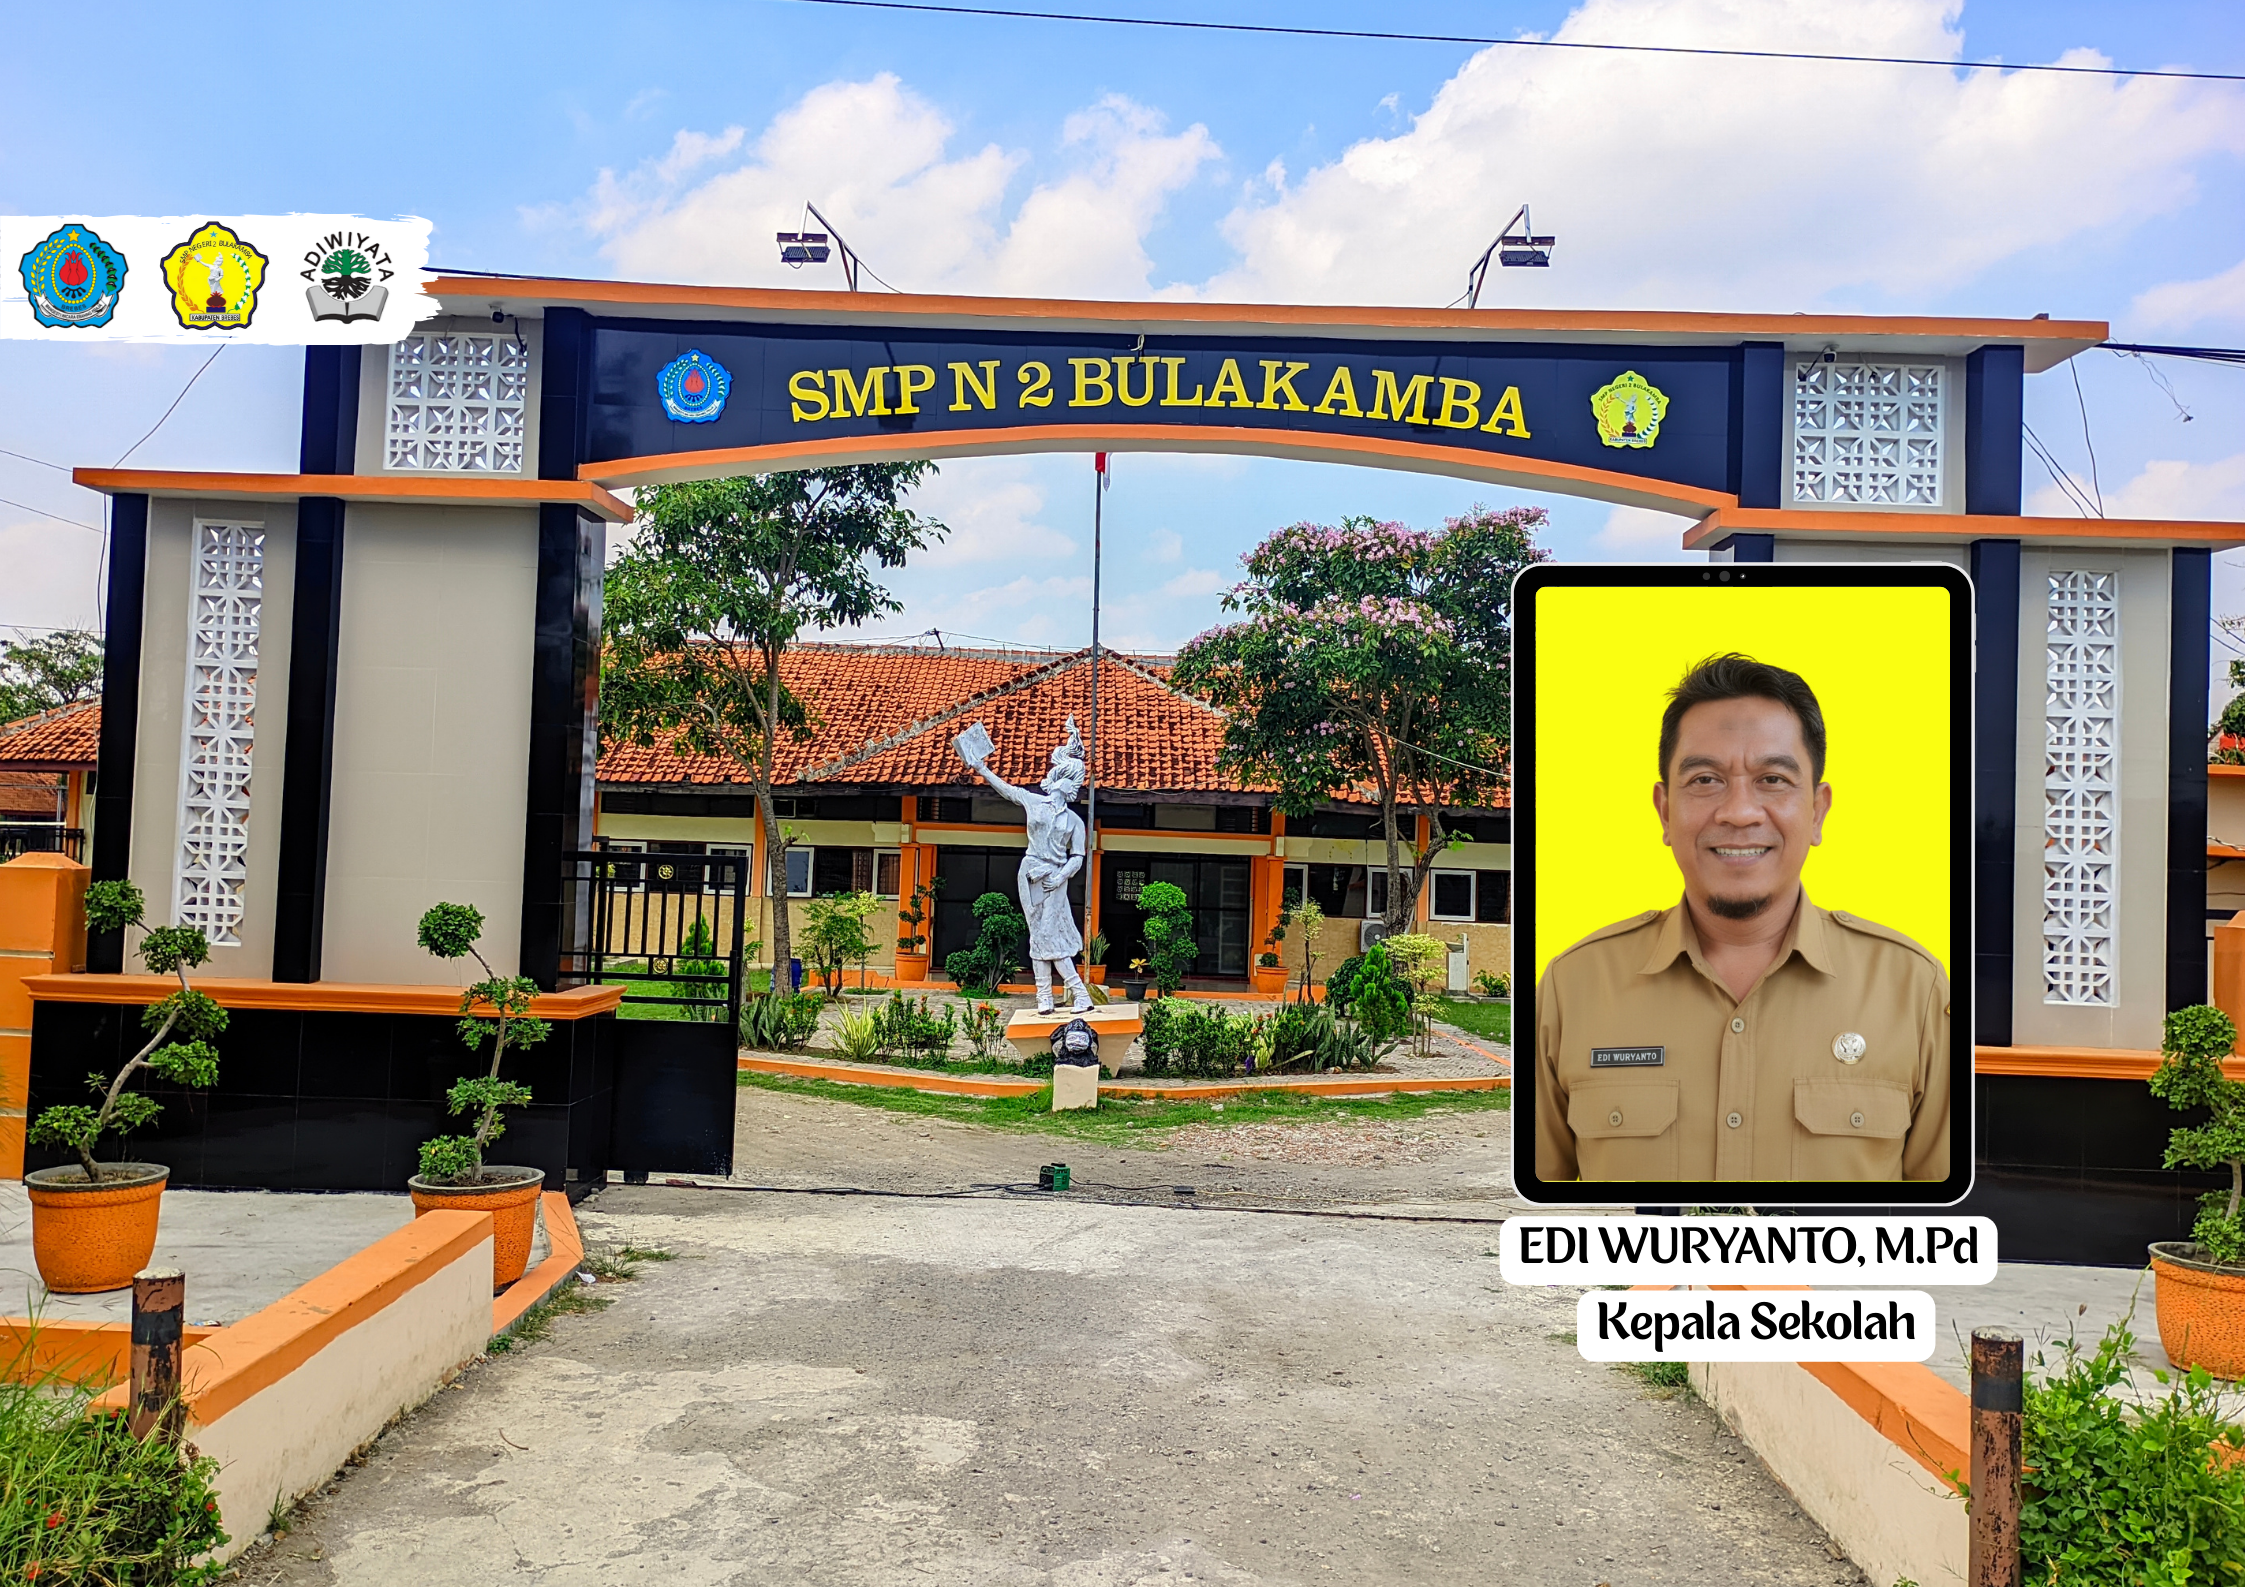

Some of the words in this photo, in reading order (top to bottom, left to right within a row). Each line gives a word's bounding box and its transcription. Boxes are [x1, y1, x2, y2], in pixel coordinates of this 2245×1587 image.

[1608, 383, 1628, 393] NEGERI
[788, 364, 937, 423] SMP
[947, 360, 1001, 412] N
[1017, 361, 1054, 409] 2
[1067, 355, 1532, 440] BULAKAMBA
[1597, 1053, 1611, 1062] EDI
[1613, 1052, 1657, 1062] WURYANTO
